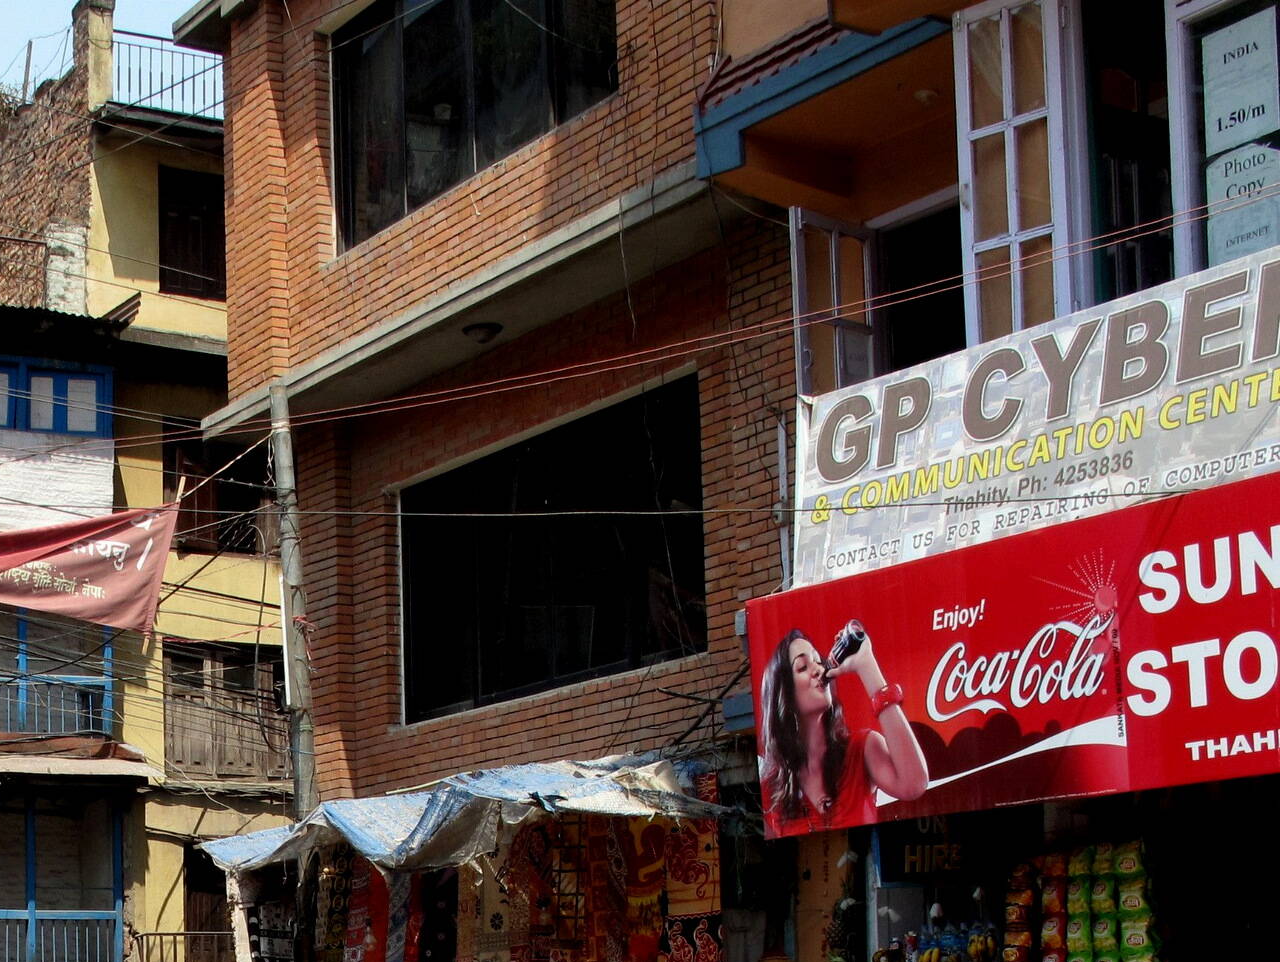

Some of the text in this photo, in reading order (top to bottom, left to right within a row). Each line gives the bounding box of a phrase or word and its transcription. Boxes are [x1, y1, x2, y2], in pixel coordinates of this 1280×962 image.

[1223, 41, 1259, 64] INDIA
[1217, 104, 1266, 132] 1.50/m
[1224, 152, 1266, 178] Photo
[1226, 177, 1265, 201] Copy
[1226, 224, 1270, 248] INTERNET
[816, 376, 933, 484] GP
[811, 493, 832, 524] &
[841, 406, 1145, 516] COMMUNICATION
[1018, 474, 1049, 495] Ph:
[1054, 450, 1134, 487] 4253836
[826, 539, 901, 570] CONTACT
[912, 530, 934, 550] US
[946, 519, 981, 541] FOR
[994, 487, 1109, 530] REPAIRING
[1123, 476, 1151, 497] OF
[932, 598, 986, 631] Enjoy!
[926, 608, 1116, 722] Coca-Cola
